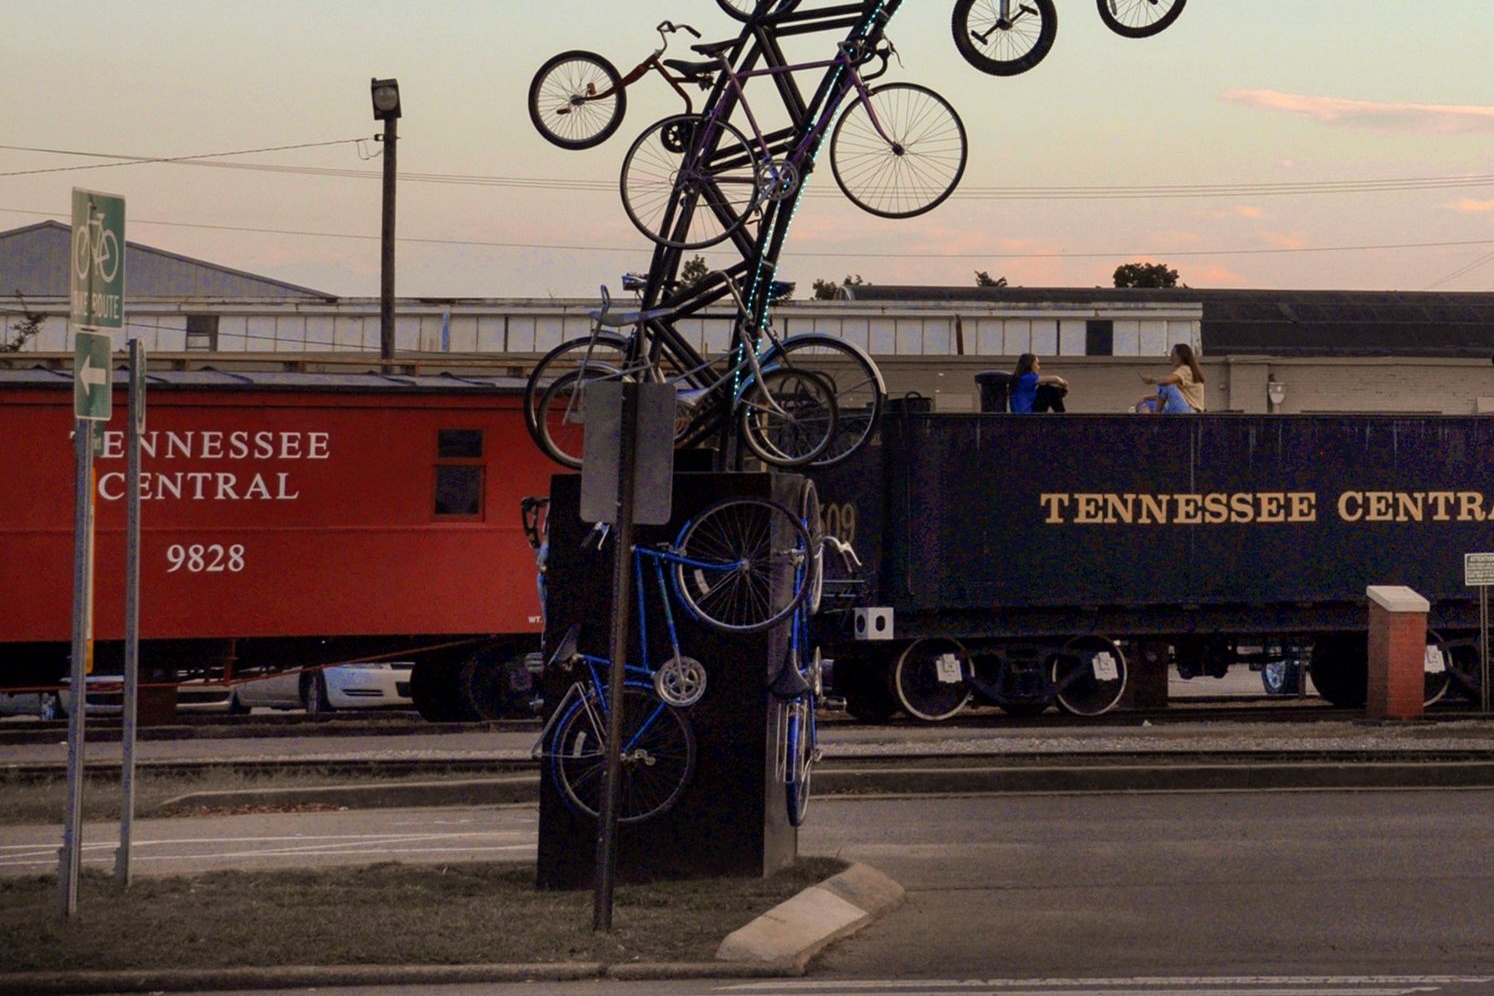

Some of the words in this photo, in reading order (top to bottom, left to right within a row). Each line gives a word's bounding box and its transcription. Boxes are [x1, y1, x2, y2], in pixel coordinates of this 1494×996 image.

[92, 292, 120, 320] ROUTE
[70, 431, 330, 459] ENNESSEE
[98, 472, 299, 500] CENTRAL
[1040, 492, 1317, 524] TENNESSEE
[166, 544, 245, 572] 9828
